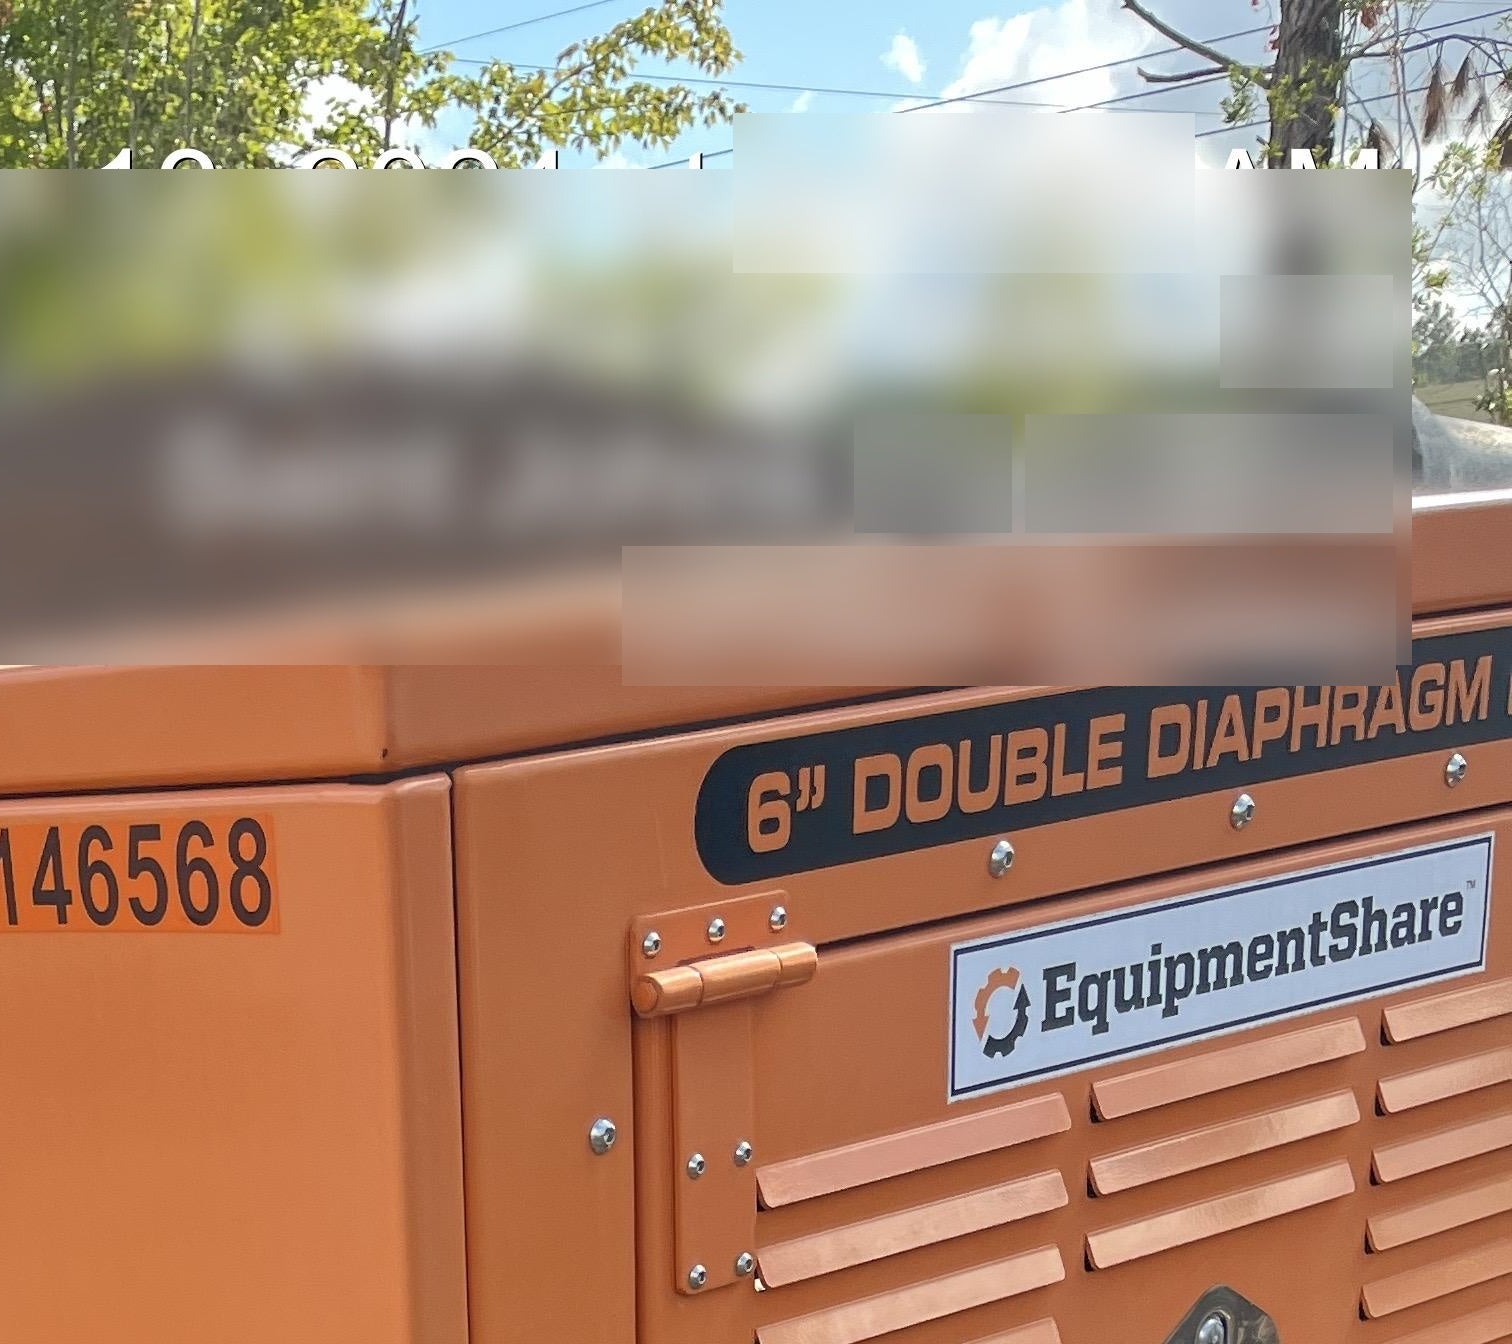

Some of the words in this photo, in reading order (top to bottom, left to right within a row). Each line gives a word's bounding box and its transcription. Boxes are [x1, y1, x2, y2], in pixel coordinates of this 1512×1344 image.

[852, 713, 1126, 835] DOUBLE
[1147, 655, 1493, 778] DIAPHRAGM
[1041, 890, 1464, 1034] EquipmentShare
